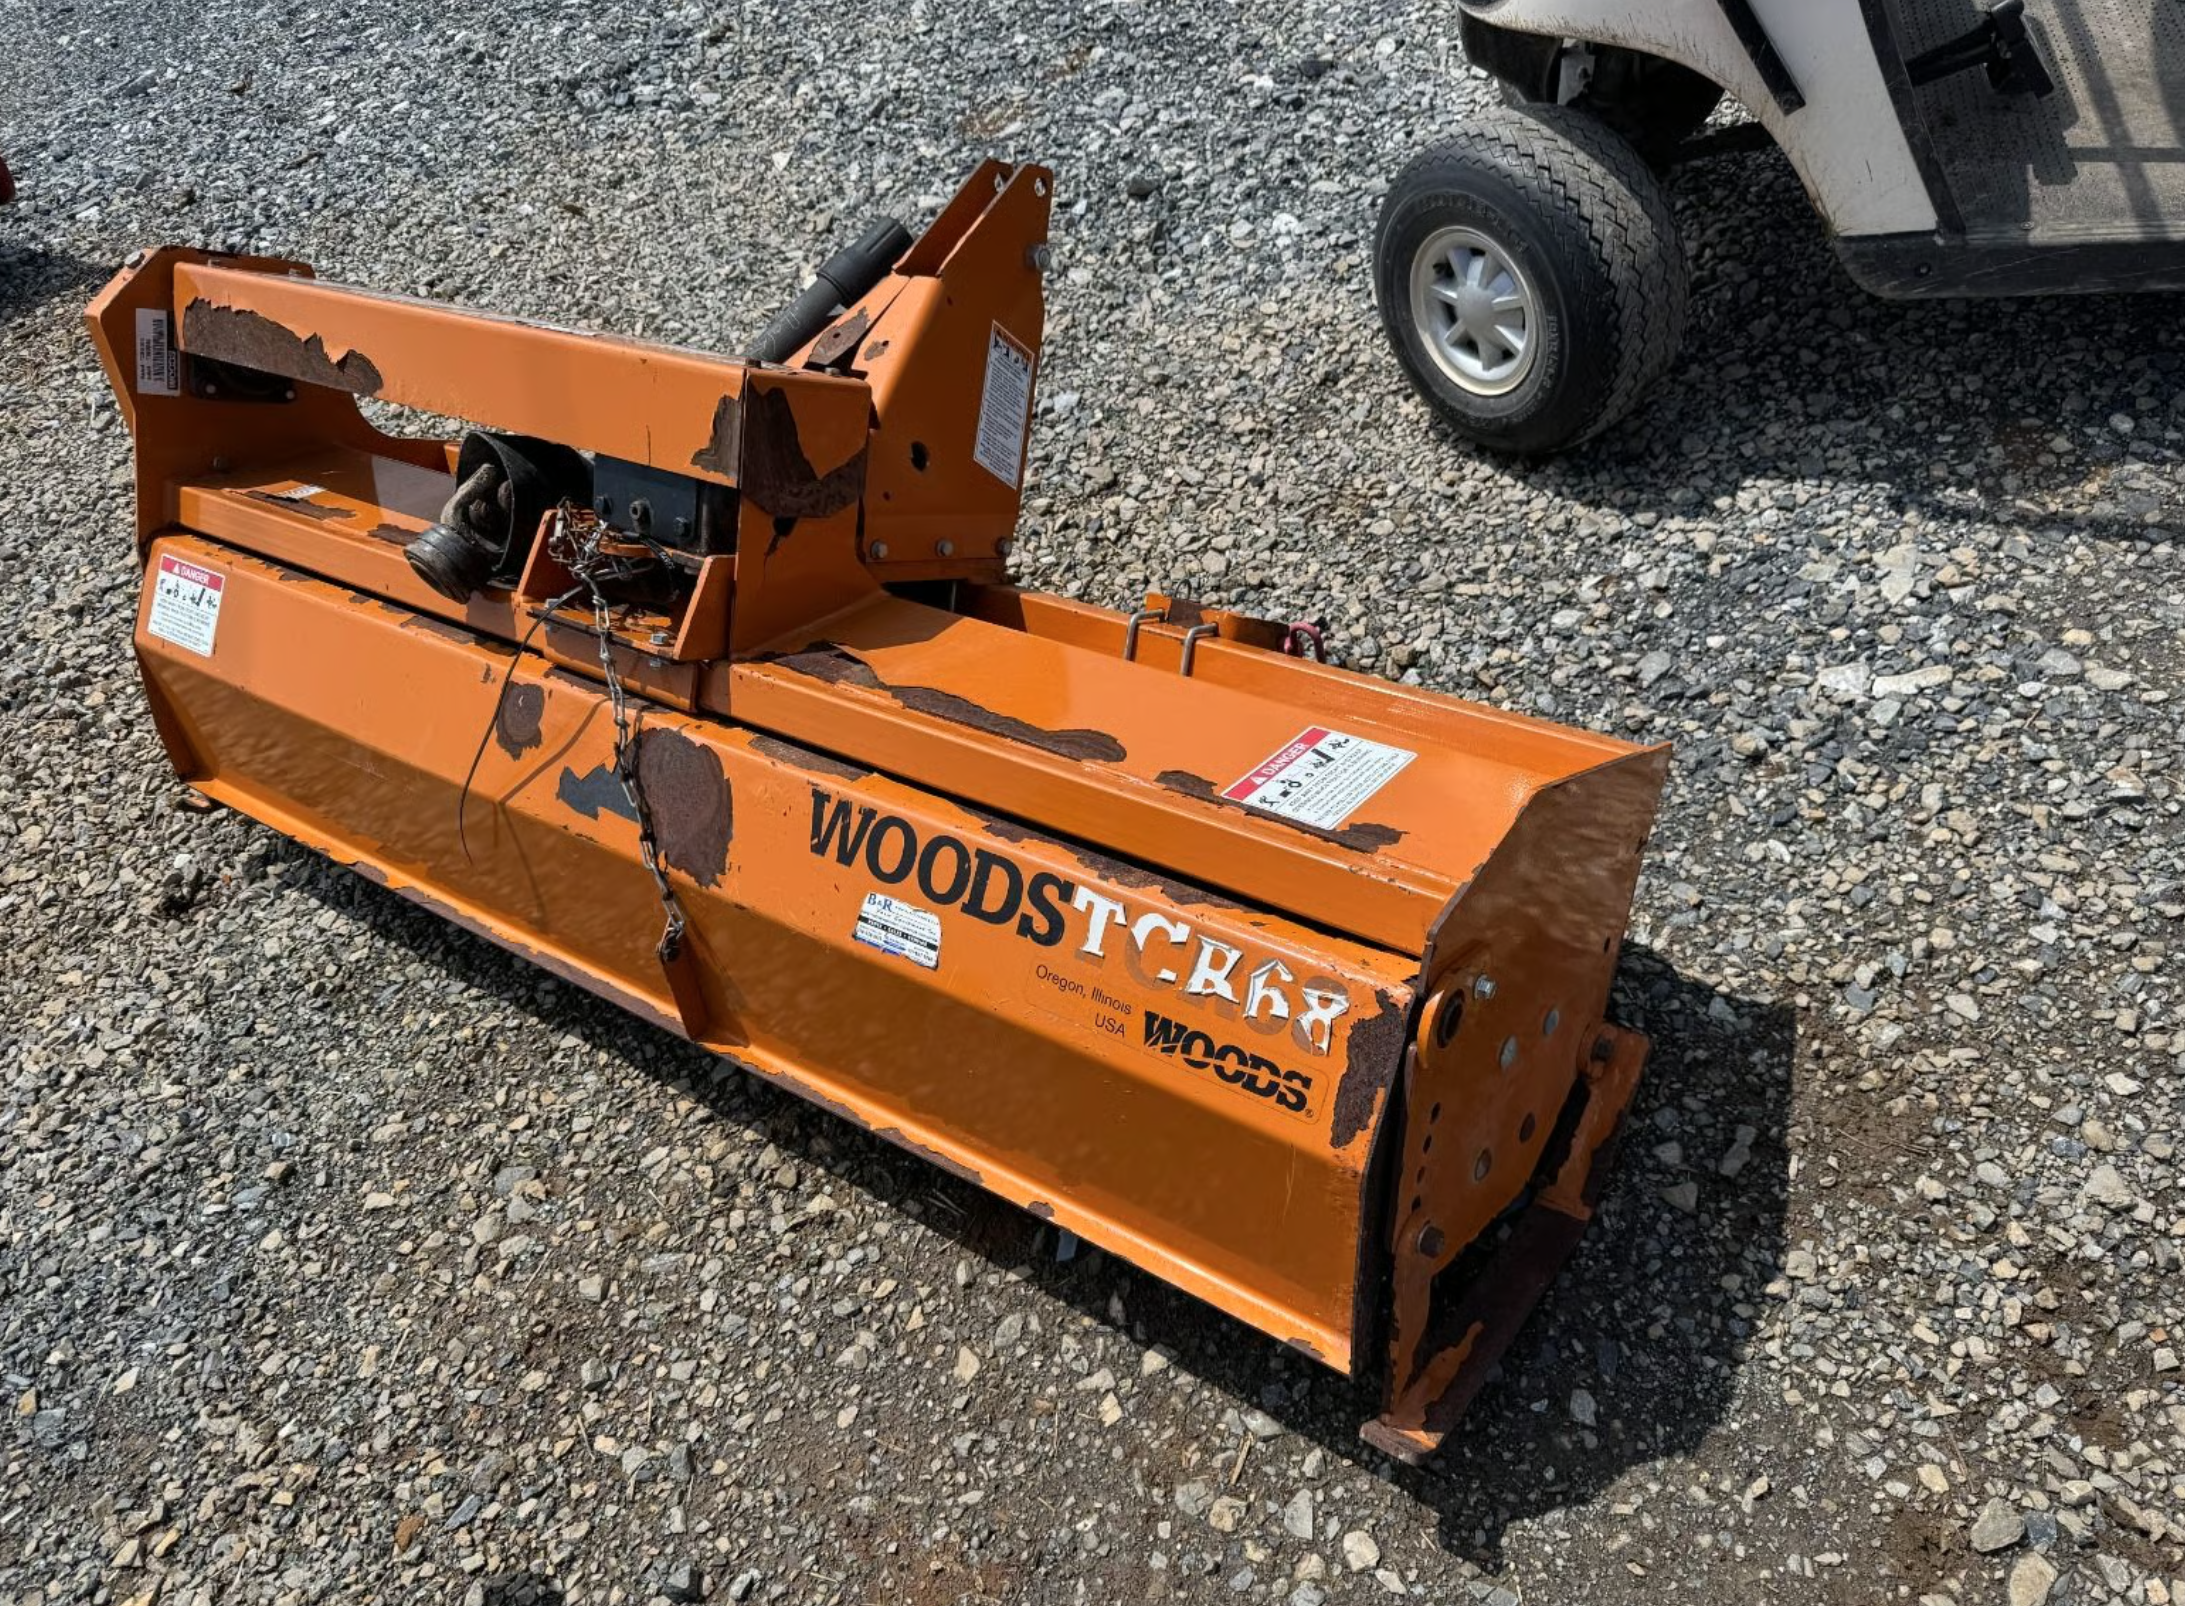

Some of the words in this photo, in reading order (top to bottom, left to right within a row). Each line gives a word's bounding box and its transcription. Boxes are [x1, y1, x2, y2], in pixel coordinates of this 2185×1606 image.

[180, 565, 210, 585] DANGER
[1261, 742, 1310, 780] DANGER
[810, 787, 1075, 947] WOODS
[1072, 886, 1350, 1056] TCR68
[1036, 964, 1087, 1000] Oregon,
[1090, 987, 1132, 1015] Illinois
[1094, 1013, 1126, 1037] USA
